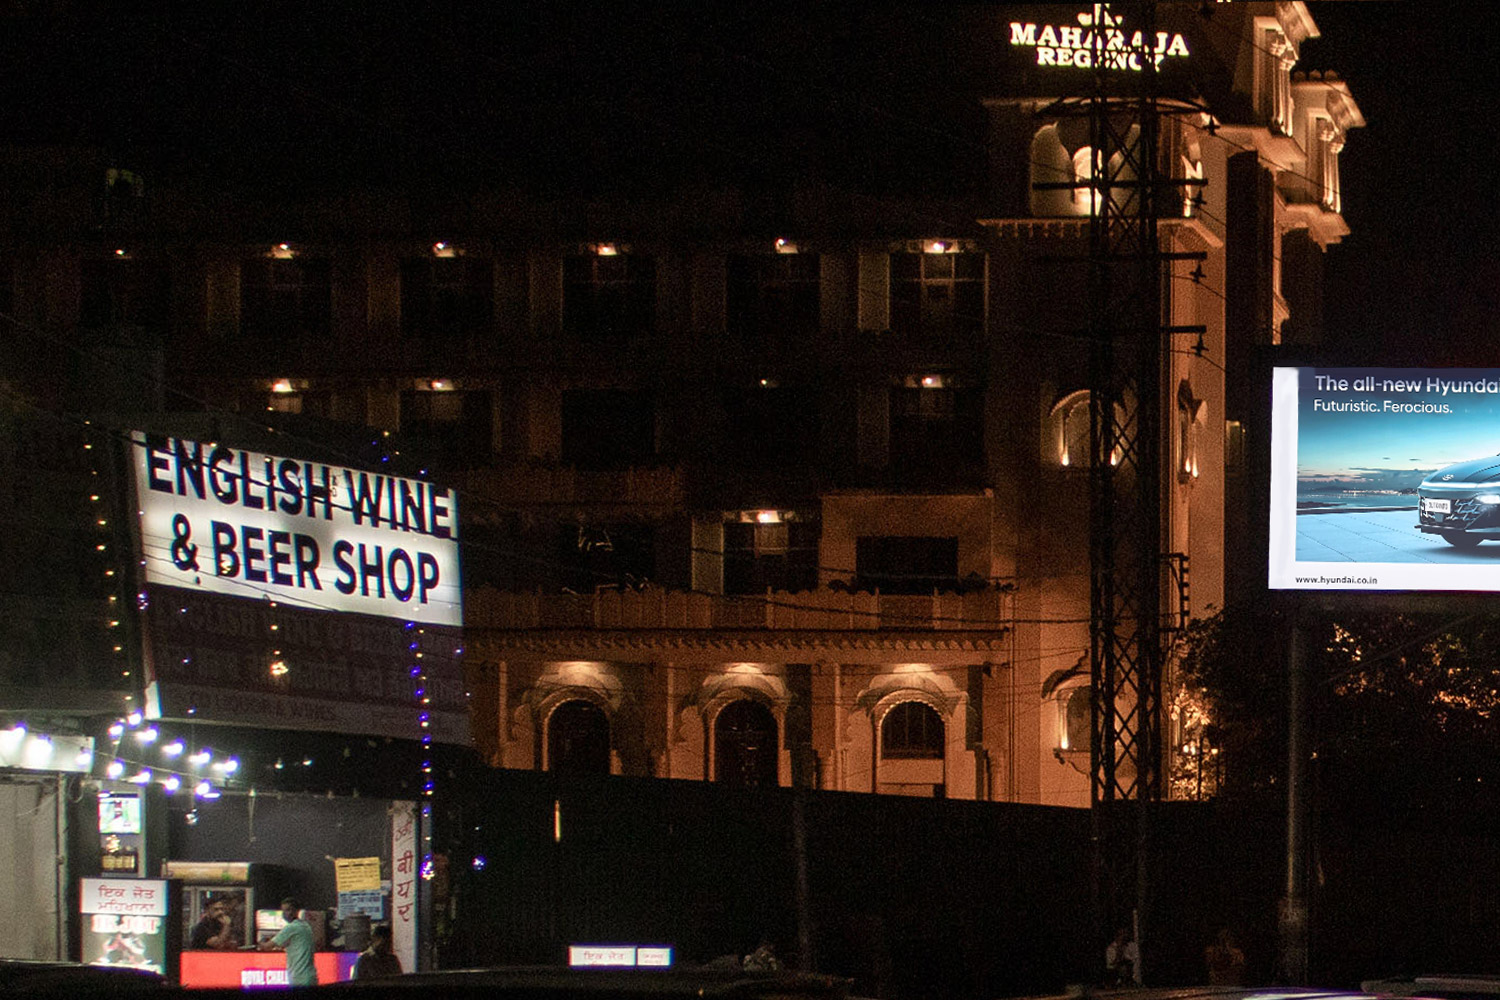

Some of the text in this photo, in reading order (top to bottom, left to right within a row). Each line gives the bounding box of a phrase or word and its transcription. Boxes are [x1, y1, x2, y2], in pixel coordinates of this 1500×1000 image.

[1315, 375, 1348, 392] The
[1353, 376, 1422, 393] all-new
[1313, 400, 1453, 414] Futuristic. Ferocious.
[146, 435, 452, 536] ENGLISH WINE
[171, 512, 440, 605] & BEER SHOP
[1295, 576, 1378, 586] www.hyundai.co.in
